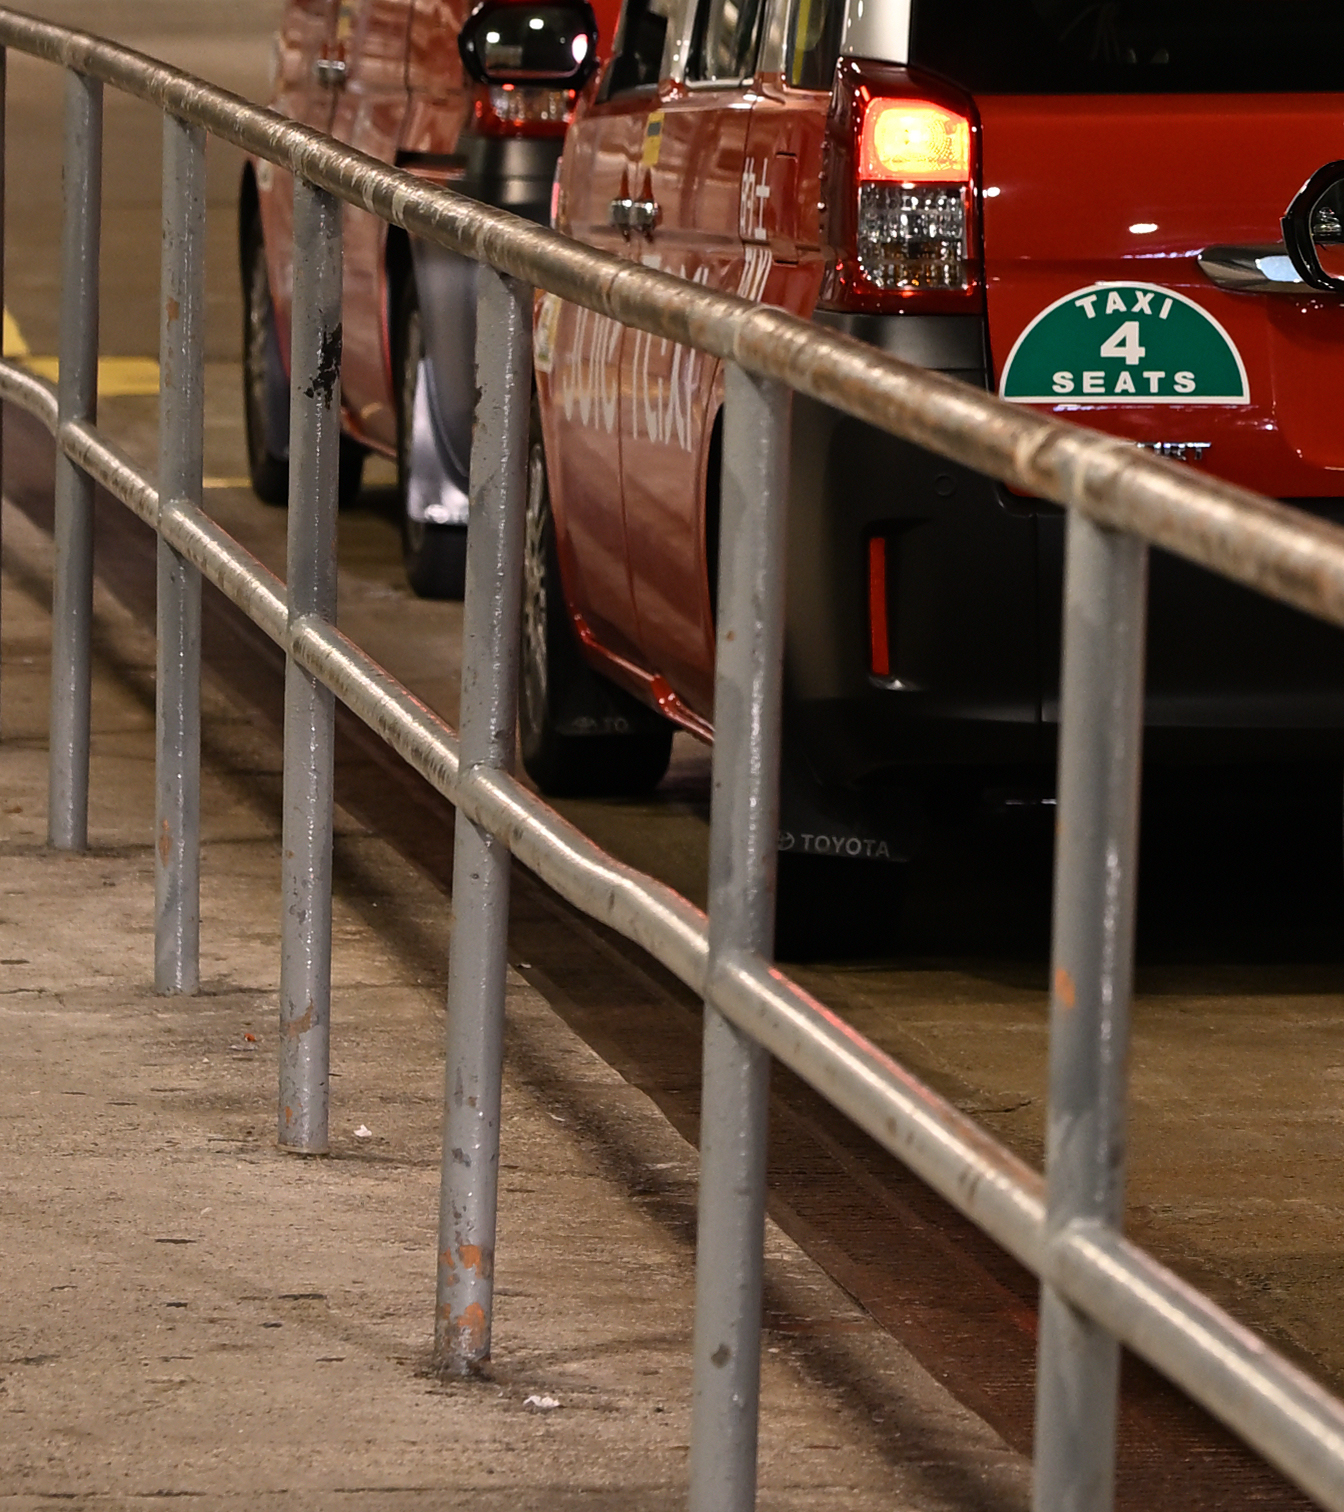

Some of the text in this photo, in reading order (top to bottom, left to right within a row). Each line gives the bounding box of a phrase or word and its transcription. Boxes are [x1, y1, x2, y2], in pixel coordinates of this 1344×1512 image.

[1075, 290, 1173, 321] TAXI
[1100, 321, 1146, 366] 4
[1052, 370, 1197, 394] SEATS
